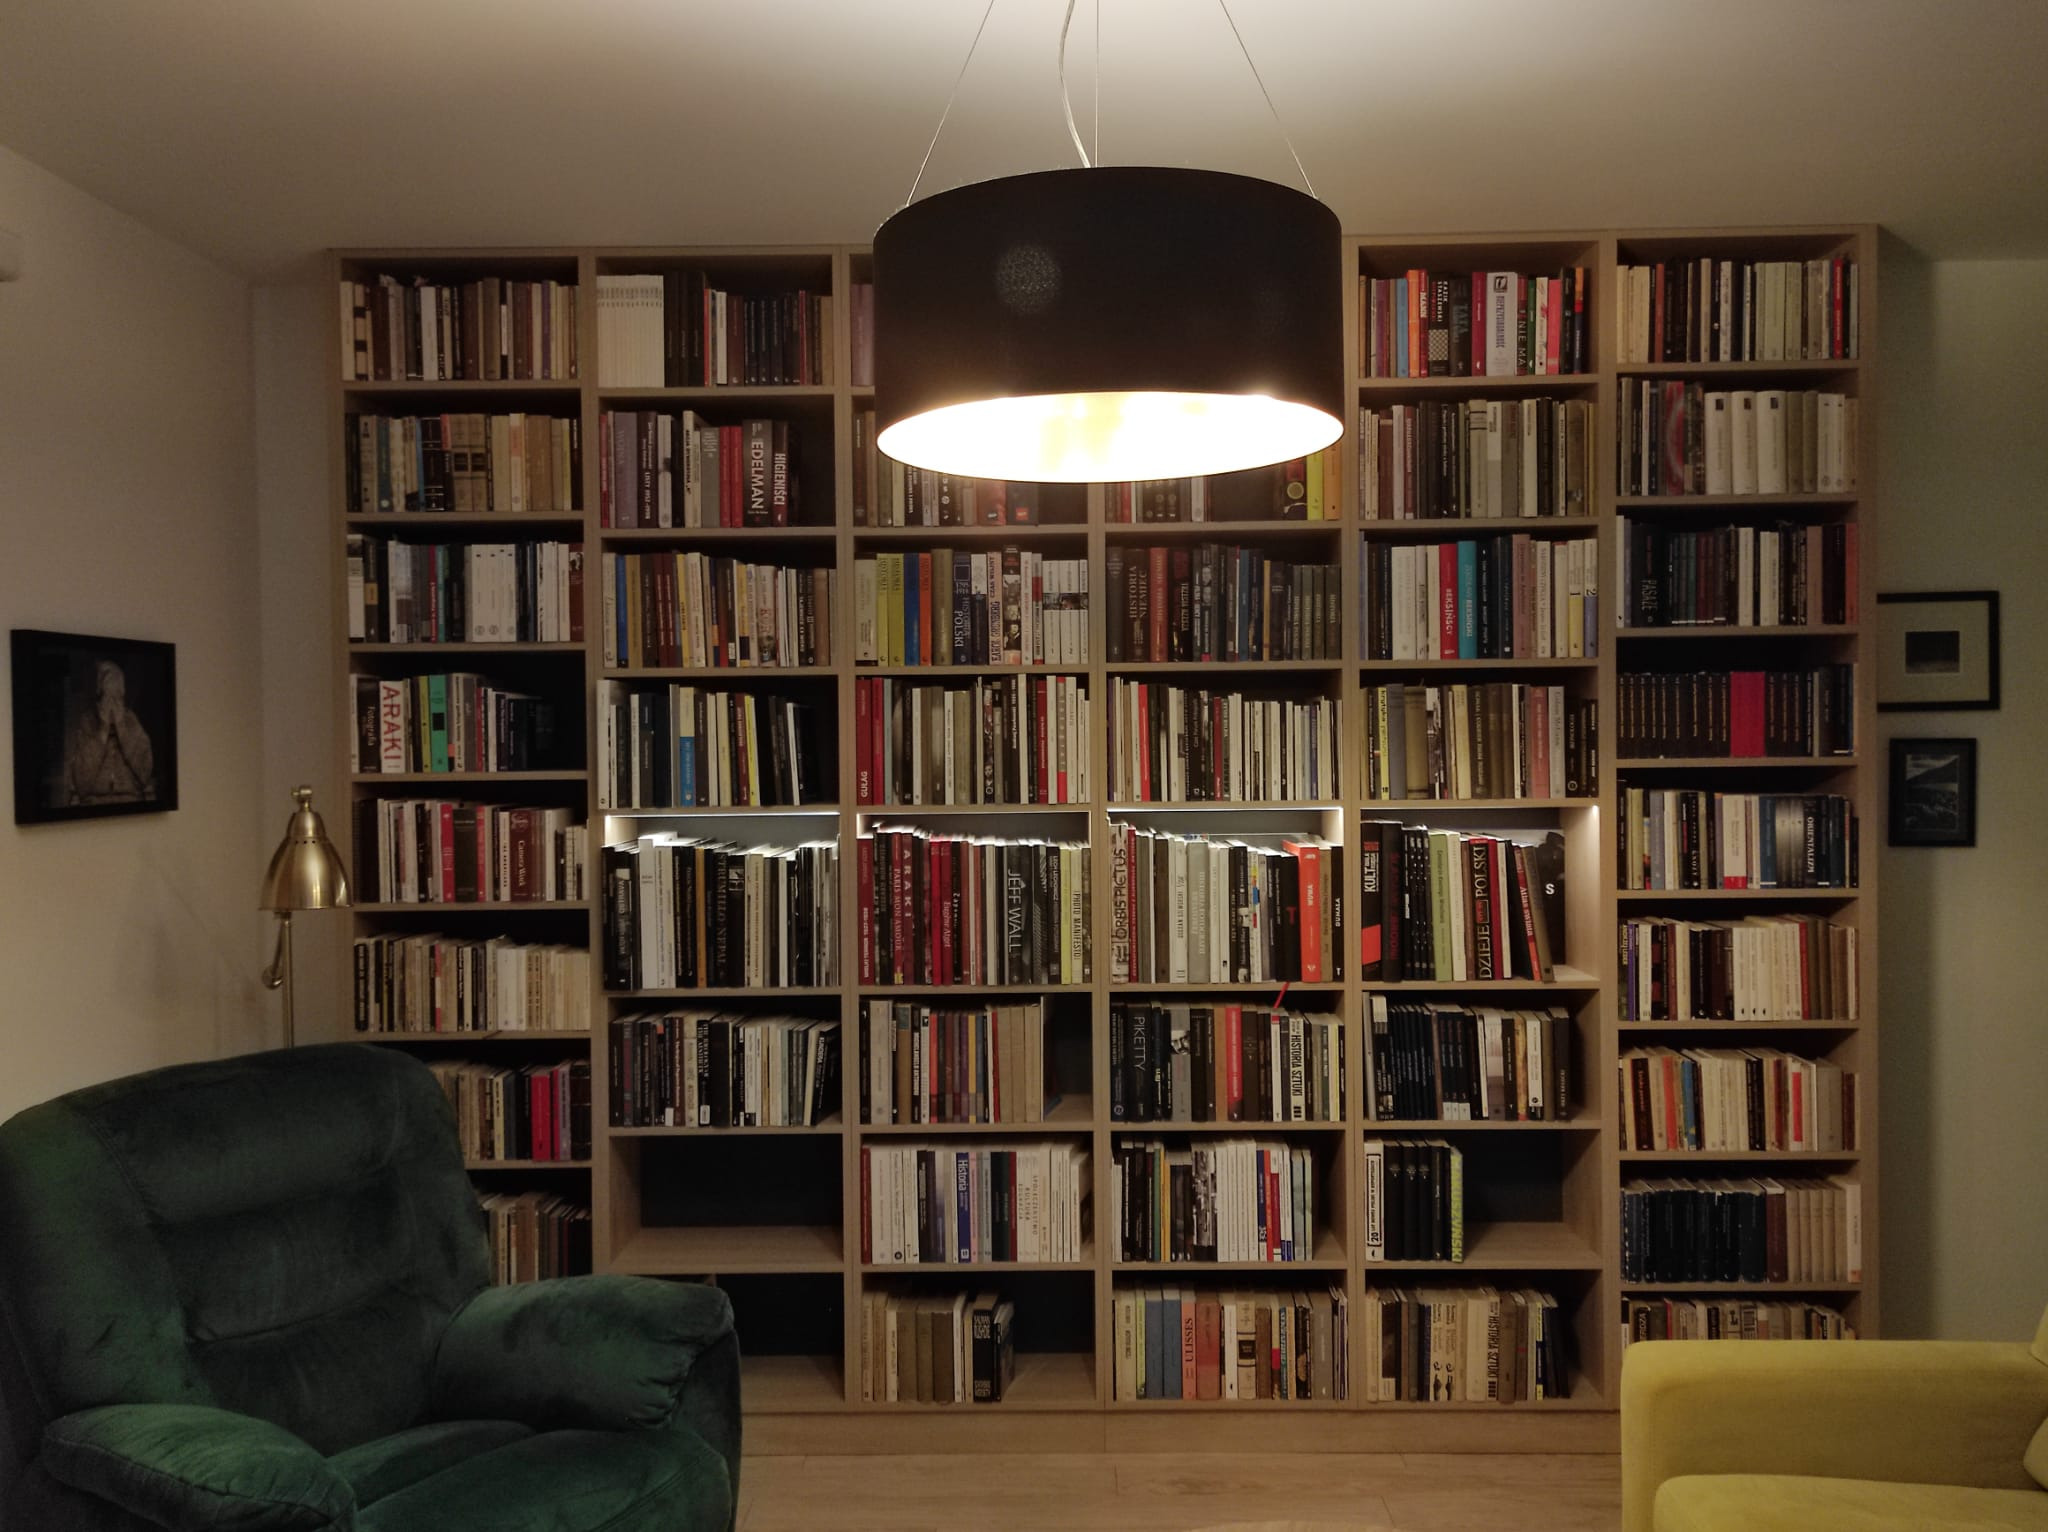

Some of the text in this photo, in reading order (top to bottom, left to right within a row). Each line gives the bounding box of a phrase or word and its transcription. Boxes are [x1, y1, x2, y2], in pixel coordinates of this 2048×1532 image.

[1419, 291, 1427, 319] MANN
[1517, 320, 1527, 367] NIE MA
[751, 440, 764, 509] EDELMAN
[774, 453, 788, 506] HIGIENIŚCI
[1128, 565, 1138, 618] HISTORIA
[1138, 570, 1148, 618] NIEMIEC
[1444, 588, 1456, 636] BEKSIŃSCY
[1585, 588, 1597, 597] 2
[953, 610, 964, 648] POLSKI
[1465, 599, 1474, 638] BEKSIŃSKI
[366, 705, 377, 747] Fotografia
[383, 686, 402, 760] ARAKI
[860, 770, 869, 798] GUŁAG
[518, 840, 527, 867] Camera
[1806, 816, 1815, 873] ORIENTALIZM
[904, 850, 912, 918] ARAKI
[1112, 848, 1127, 939] ORBIS PICTUS
[1364, 869, 1377, 893] KULT
[1473, 846, 1489, 898] POLSKI
[1545, 883, 1556, 895] S
[617, 880, 626, 914] OSTRAVA
[894, 868, 903, 952] PARIS MON AMOUR
[1008, 868, 1022, 954] JEFF WALL
[942, 901, 952, 948] Eugène Atget
[1072, 893, 1082, 958] PHOTO MANIFESTO
[1477, 925, 1493, 979] DZIEJE
[817, 1036, 826, 1064] KUNDERA
[1133, 1016, 1146, 1071] PIKETTY
[1291, 1034, 1303, 1096] HISTORIA SZTUKI
[958, 1159, 969, 1191] Historia
[1370, 1232, 1379, 1243] 20
[1185, 1318, 1193, 1363] ULISSES
[1488, 1315, 1500, 1378] HISTORIA SZTUKI
